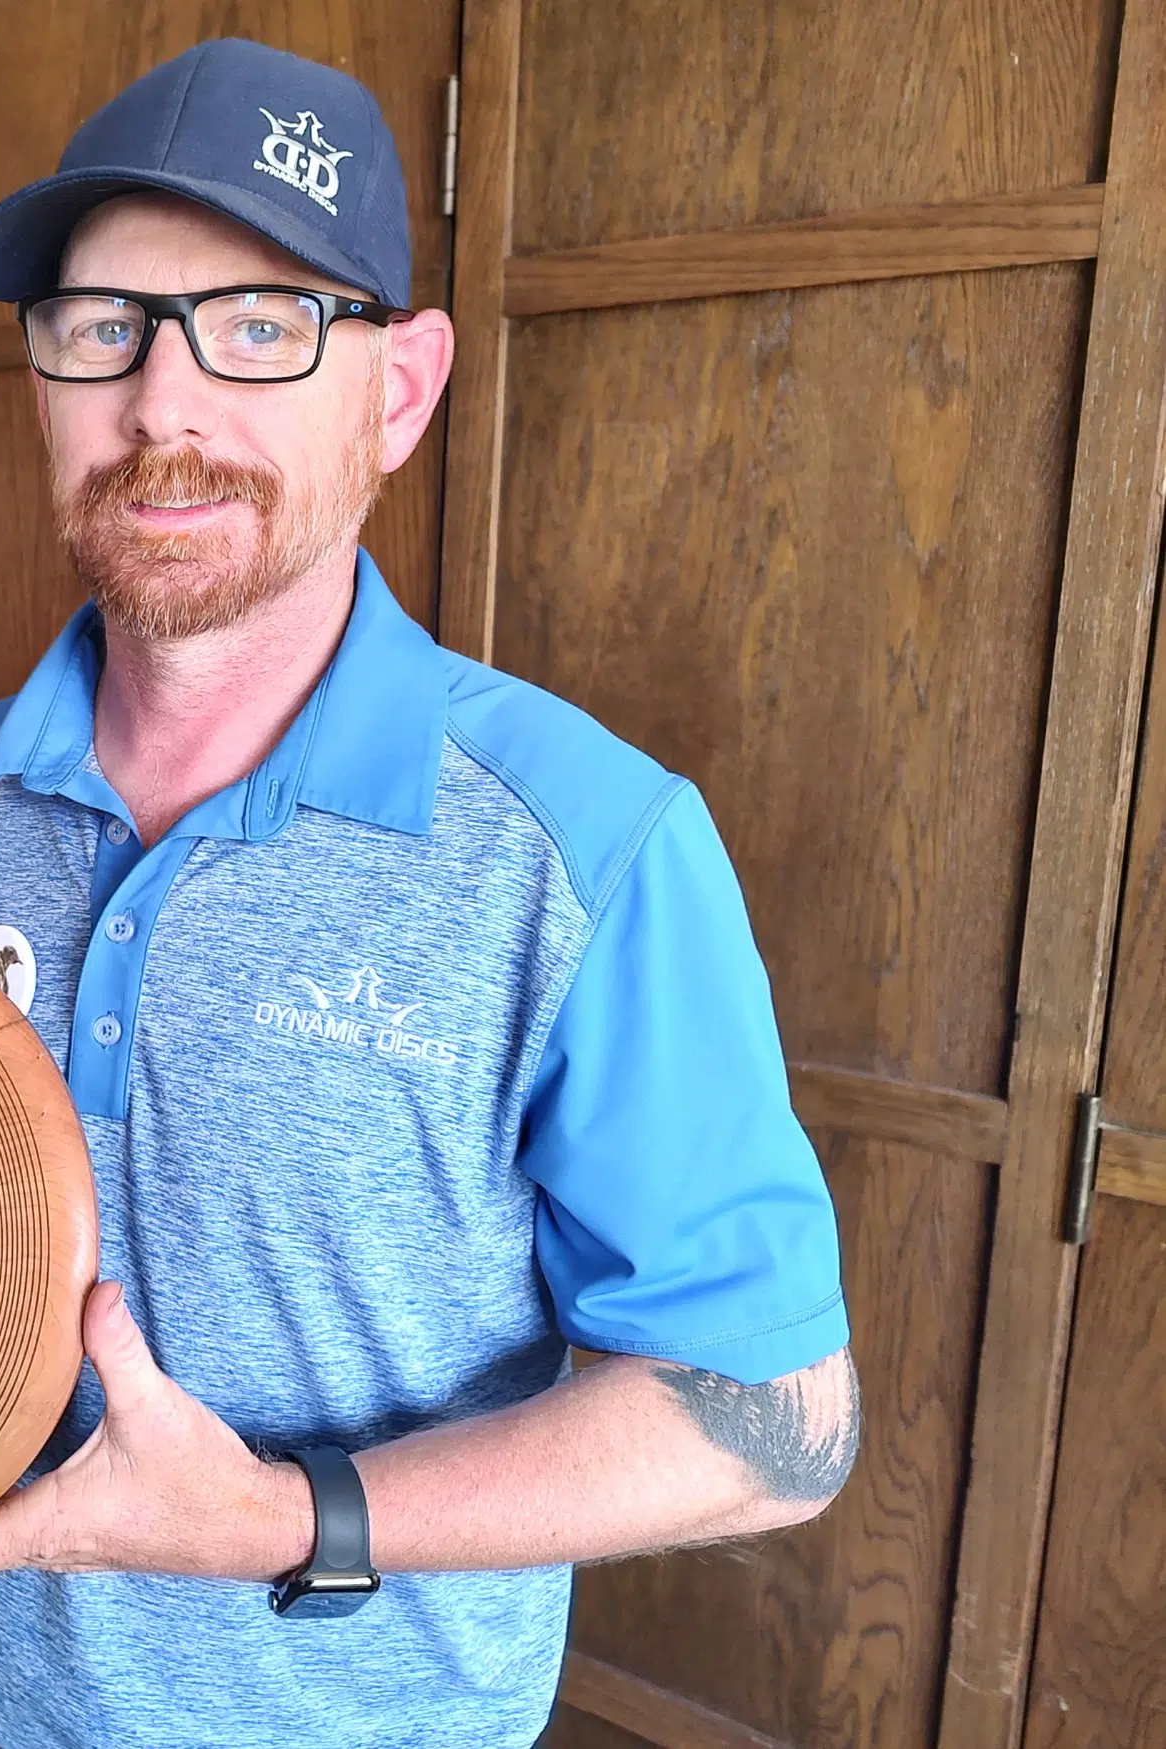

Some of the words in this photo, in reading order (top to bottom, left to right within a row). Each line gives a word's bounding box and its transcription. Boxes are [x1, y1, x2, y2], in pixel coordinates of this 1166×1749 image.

[252, 159, 308, 193] DYNAMIC
[254, 1001, 371, 1048] DYNAMIC
[376, 1028, 459, 1066] DISCS
